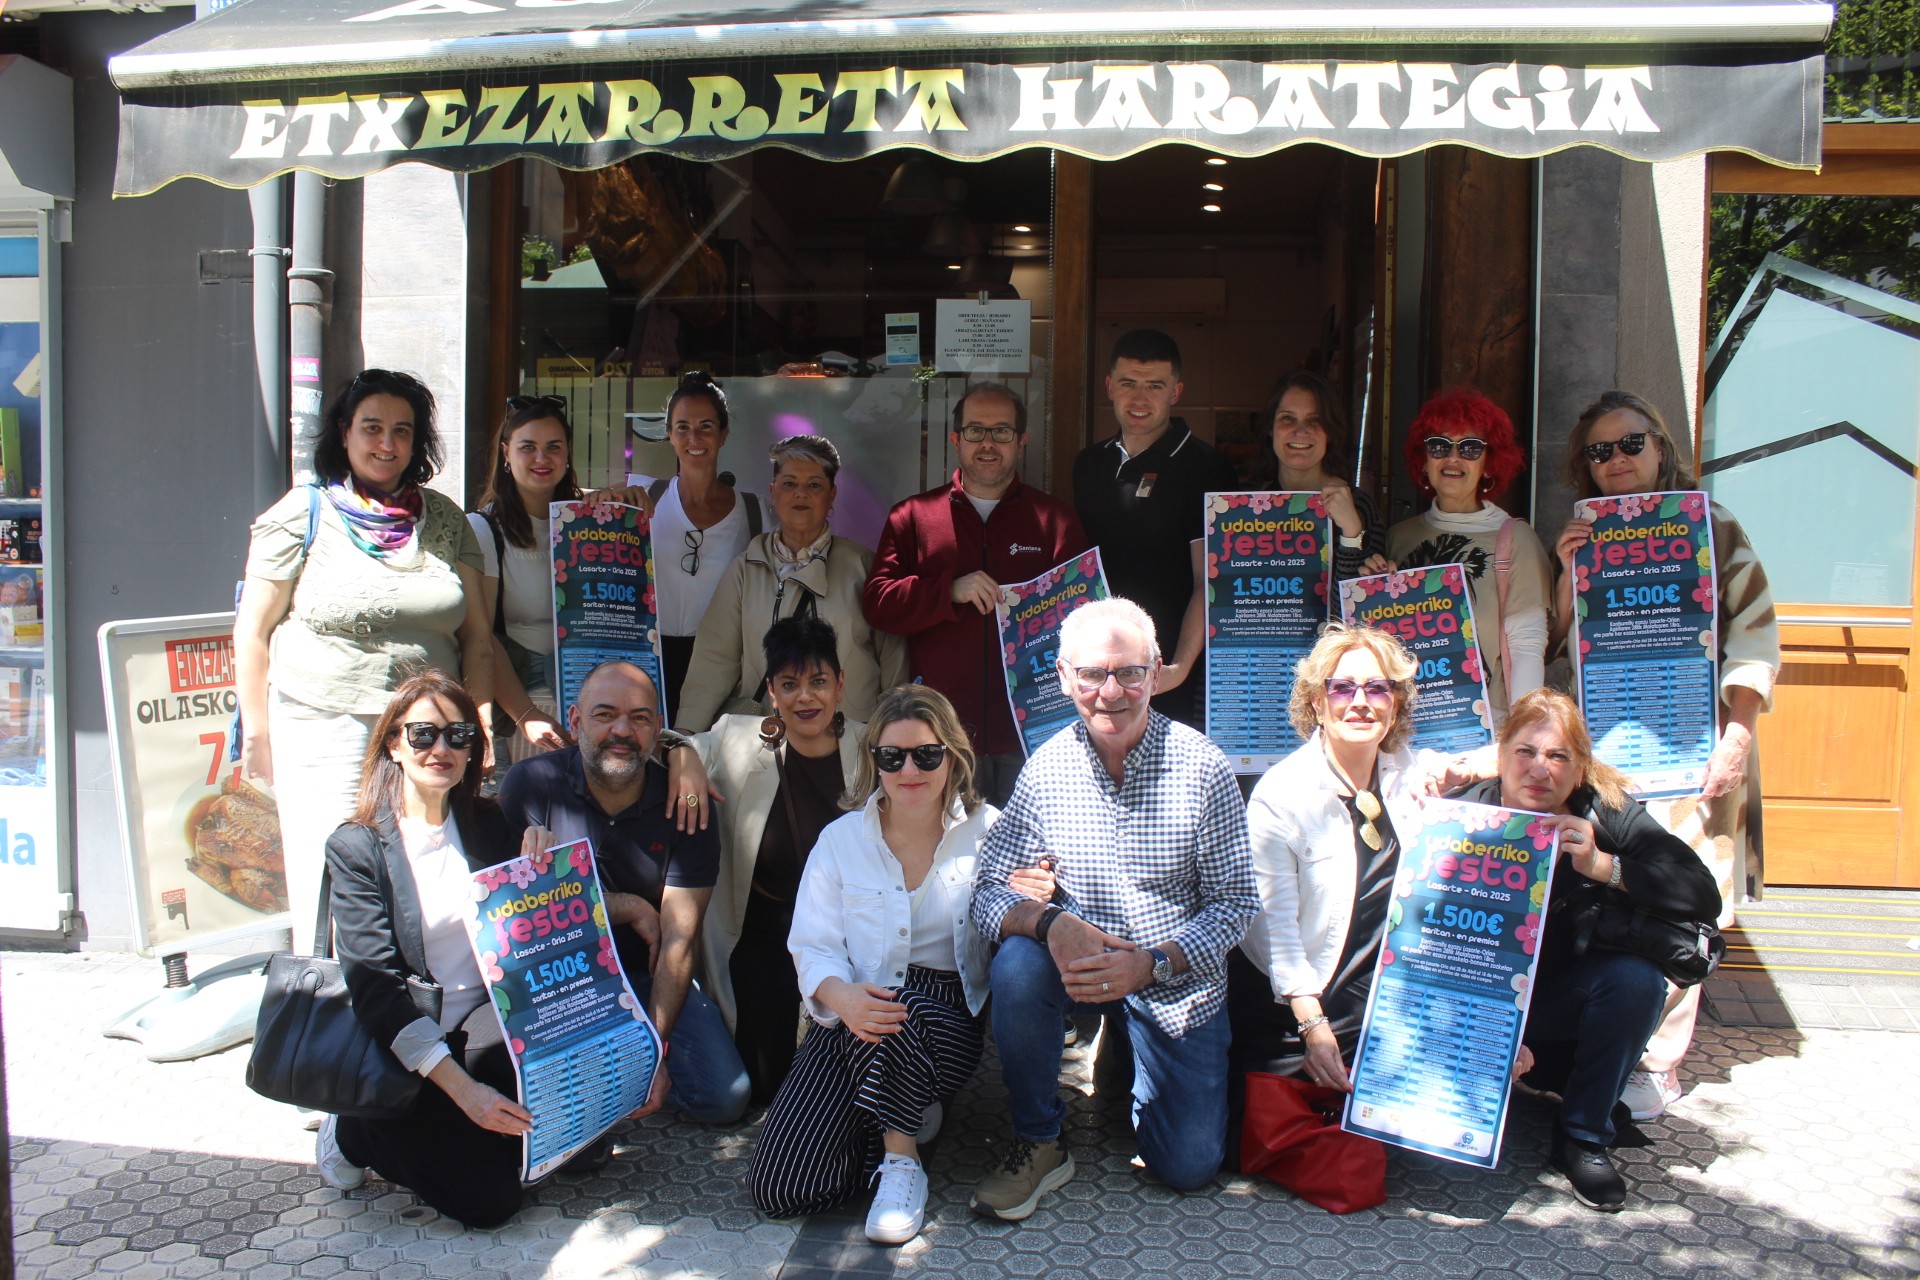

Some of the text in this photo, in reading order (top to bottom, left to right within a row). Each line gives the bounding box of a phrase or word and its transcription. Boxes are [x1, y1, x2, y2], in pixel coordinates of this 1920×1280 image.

[229, 66, 968, 161] ETXEZARRETA
[568, 527, 640, 546] udaberriko
[1220, 518, 1315, 533] udaberriko
[1590, 522, 1690, 543] udaberriko
[568, 537, 643, 567] festa
[1220, 529, 1317, 562] festa
[1591, 535, 1692, 574] festa
[579, 565, 606, 574] Lasarte
[624, 568, 637, 576] 2025
[1602, 570, 1635, 578] Lasarte
[1661, 564, 1681, 573] 2025
[582, 582, 636, 602] 1.500€
[1233, 576, 1304, 596] 1.500€
[1605, 583, 1681, 609] 1.500€
[616, 604, 636, 612] premios
[1016, 582, 1088, 622] udaberriko
[1276, 598, 1304, 606] premios
[1361, 596, 1452, 622] udaberriko
[1651, 606, 1681, 616] premios
[1431, 638, 1450, 647] 2025
[1426, 679, 1453, 690] premios
[1425, 835, 1530, 863] udaberriko
[1416, 847, 1529, 891] festa
[486, 881, 582, 922] udaberriko
[1427, 880, 1462, 894] Lasarte
[1490, 890, 1511, 902] 2025
[494, 899, 589, 958] festa
[1423, 901, 1505, 936] 1.500€
[514, 944, 545, 960] Lasarte
[567, 929, 583, 942] 2025
[1456, 933, 1468, 941] en
[1468, 935, 1500, 946] premios
[525, 951, 590, 992] 1.500€
[560, 984, 570, 993] en
[570, 975, 594, 991] premios
